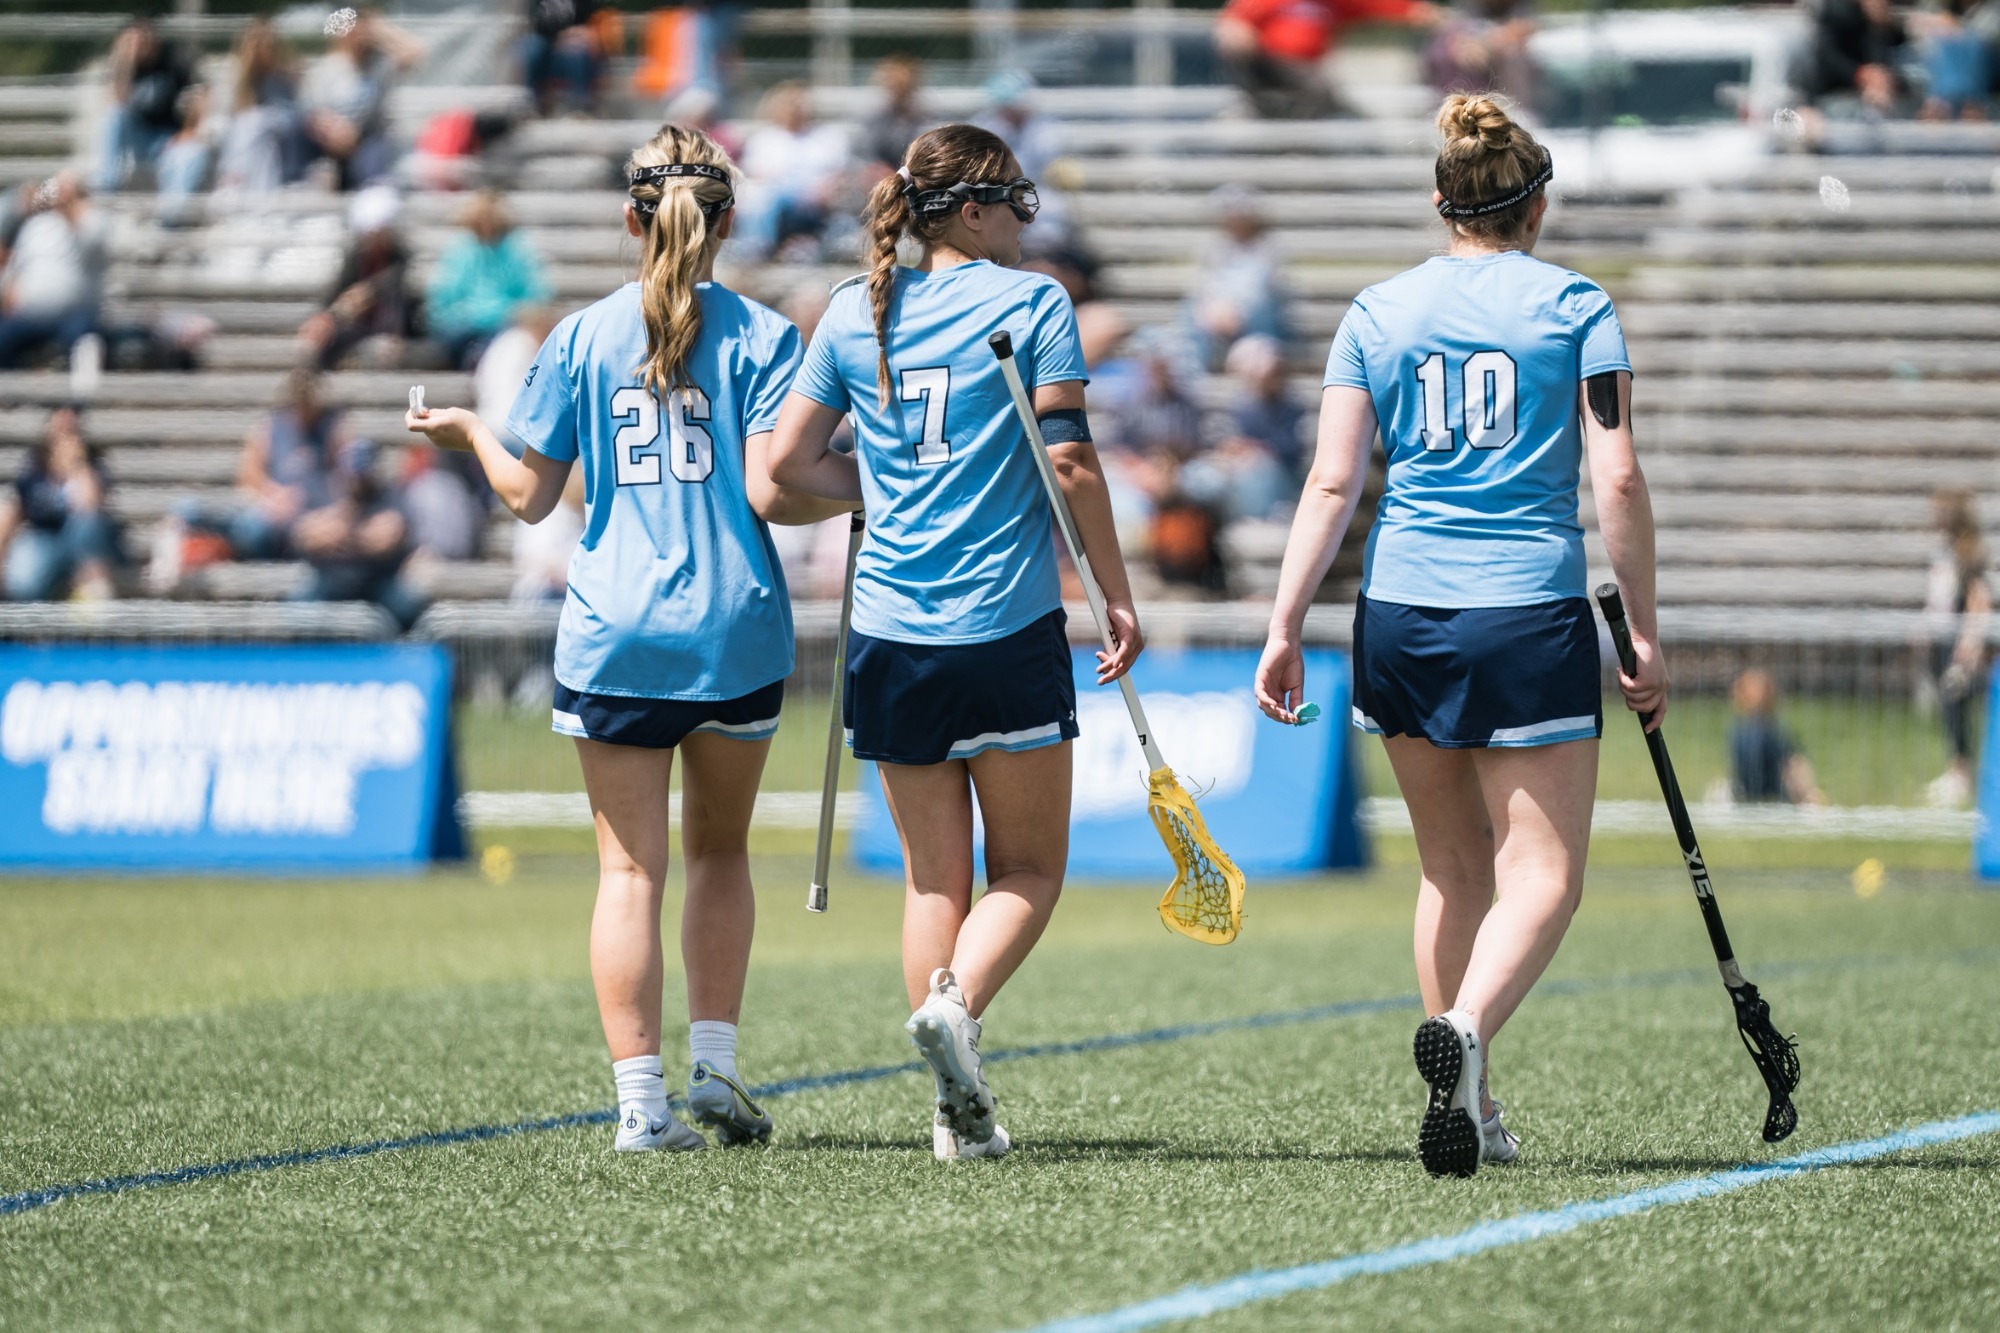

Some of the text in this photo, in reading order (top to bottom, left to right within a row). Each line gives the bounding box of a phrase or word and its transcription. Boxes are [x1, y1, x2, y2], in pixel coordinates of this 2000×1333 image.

[650, 163, 683, 177] STX
[694, 164, 721, 179] STX
[1478, 190, 1528, 213] ARMOUR
[901, 365, 951, 466] 7
[1415, 349, 1518, 451] 10
[611, 386, 714, 486] 26
[1682, 845, 1714, 898] STX
